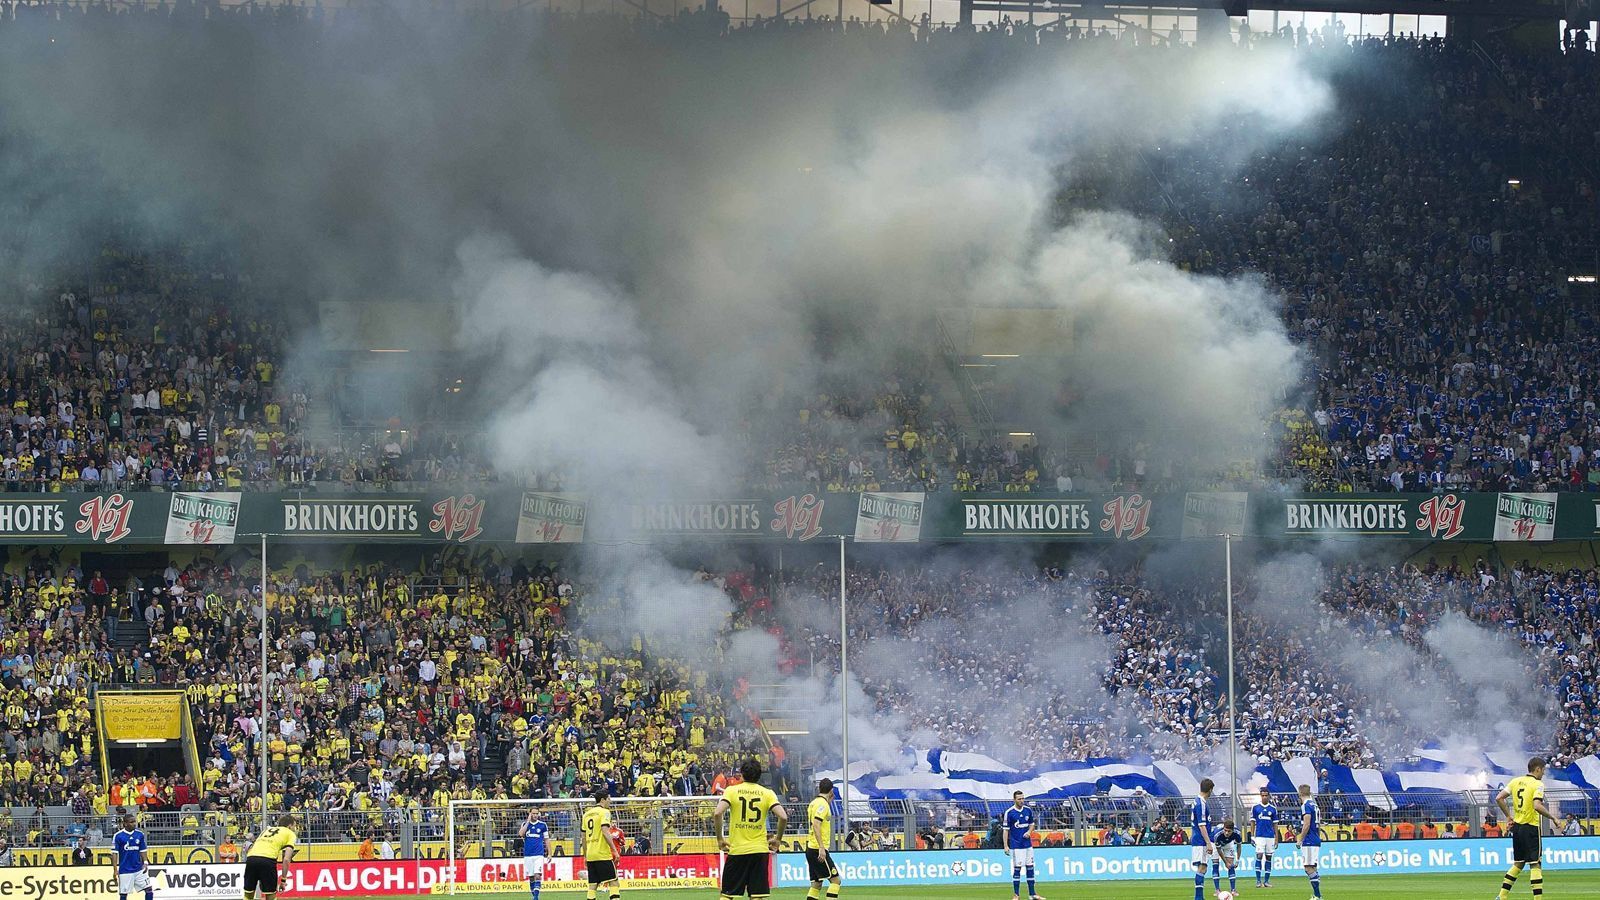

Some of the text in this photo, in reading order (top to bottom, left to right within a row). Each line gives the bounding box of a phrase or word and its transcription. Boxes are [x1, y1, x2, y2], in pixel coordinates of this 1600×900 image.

[284, 504, 418, 531] BRINKHOFF's
[965, 504, 1090, 530] BRINKHOFF's
[1287, 503, 1407, 529] BRINKHOFF's
[738, 796, 762, 822] 15
[1517, 789, 1525, 809] 5
[588, 819, 594, 837] 9
[735, 823, 763, 831] DORTMUND
[966, 859, 1004, 876] Die
[1063, 856, 1082, 874] in
[1388, 850, 1422, 867] Die
[1428, 849, 1457, 866] Nr.
[1479, 847, 1500, 865] in
[165, 868, 241, 888] weber
[435, 883, 468, 892] SIGAL
[467, 883, 492, 891] IDUNA
[627, 880, 656, 888] SIGNAL
